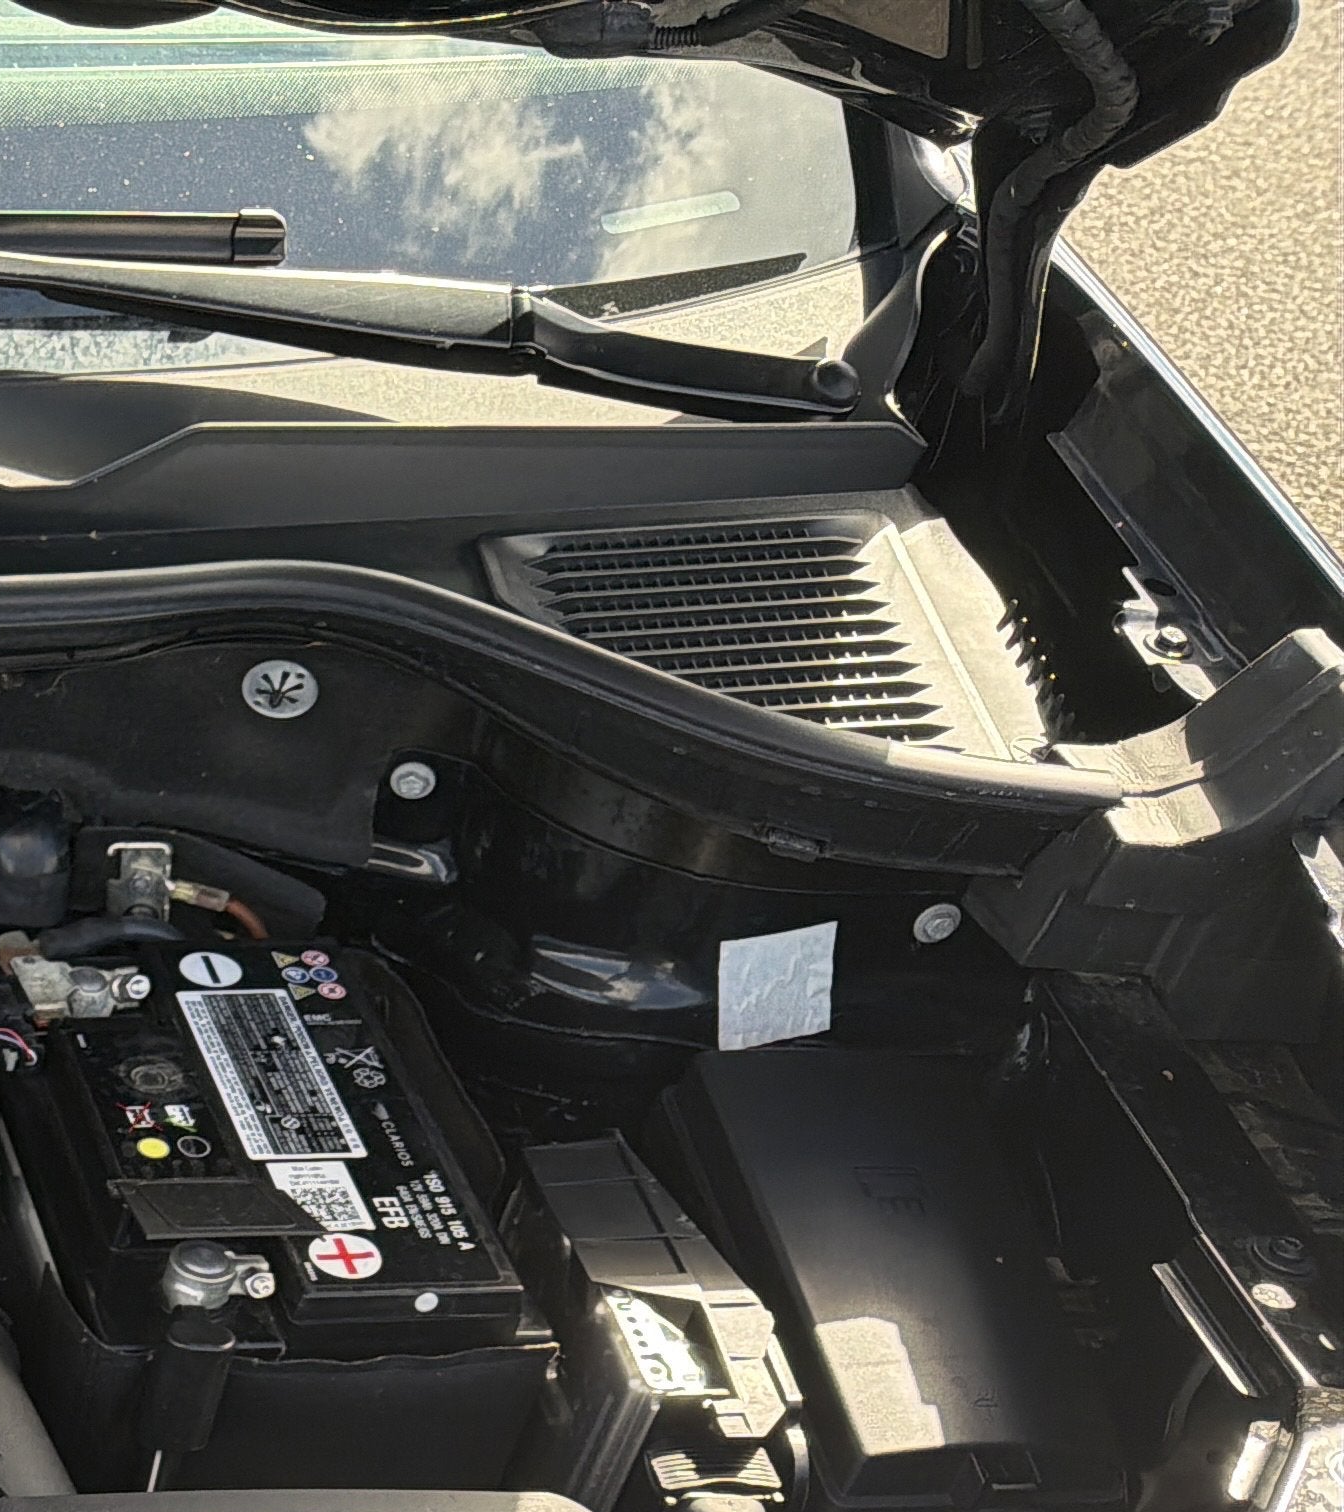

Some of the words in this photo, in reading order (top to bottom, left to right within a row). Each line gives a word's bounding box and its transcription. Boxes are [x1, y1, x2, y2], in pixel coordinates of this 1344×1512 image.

[381, 1121, 414, 1167] CLARIOS
[372, 1196, 410, 1229] EFB
[434, 1196, 457, 1216] 915
[447, 1220, 469, 1239] 105
[457, 1241, 476, 1251] A
